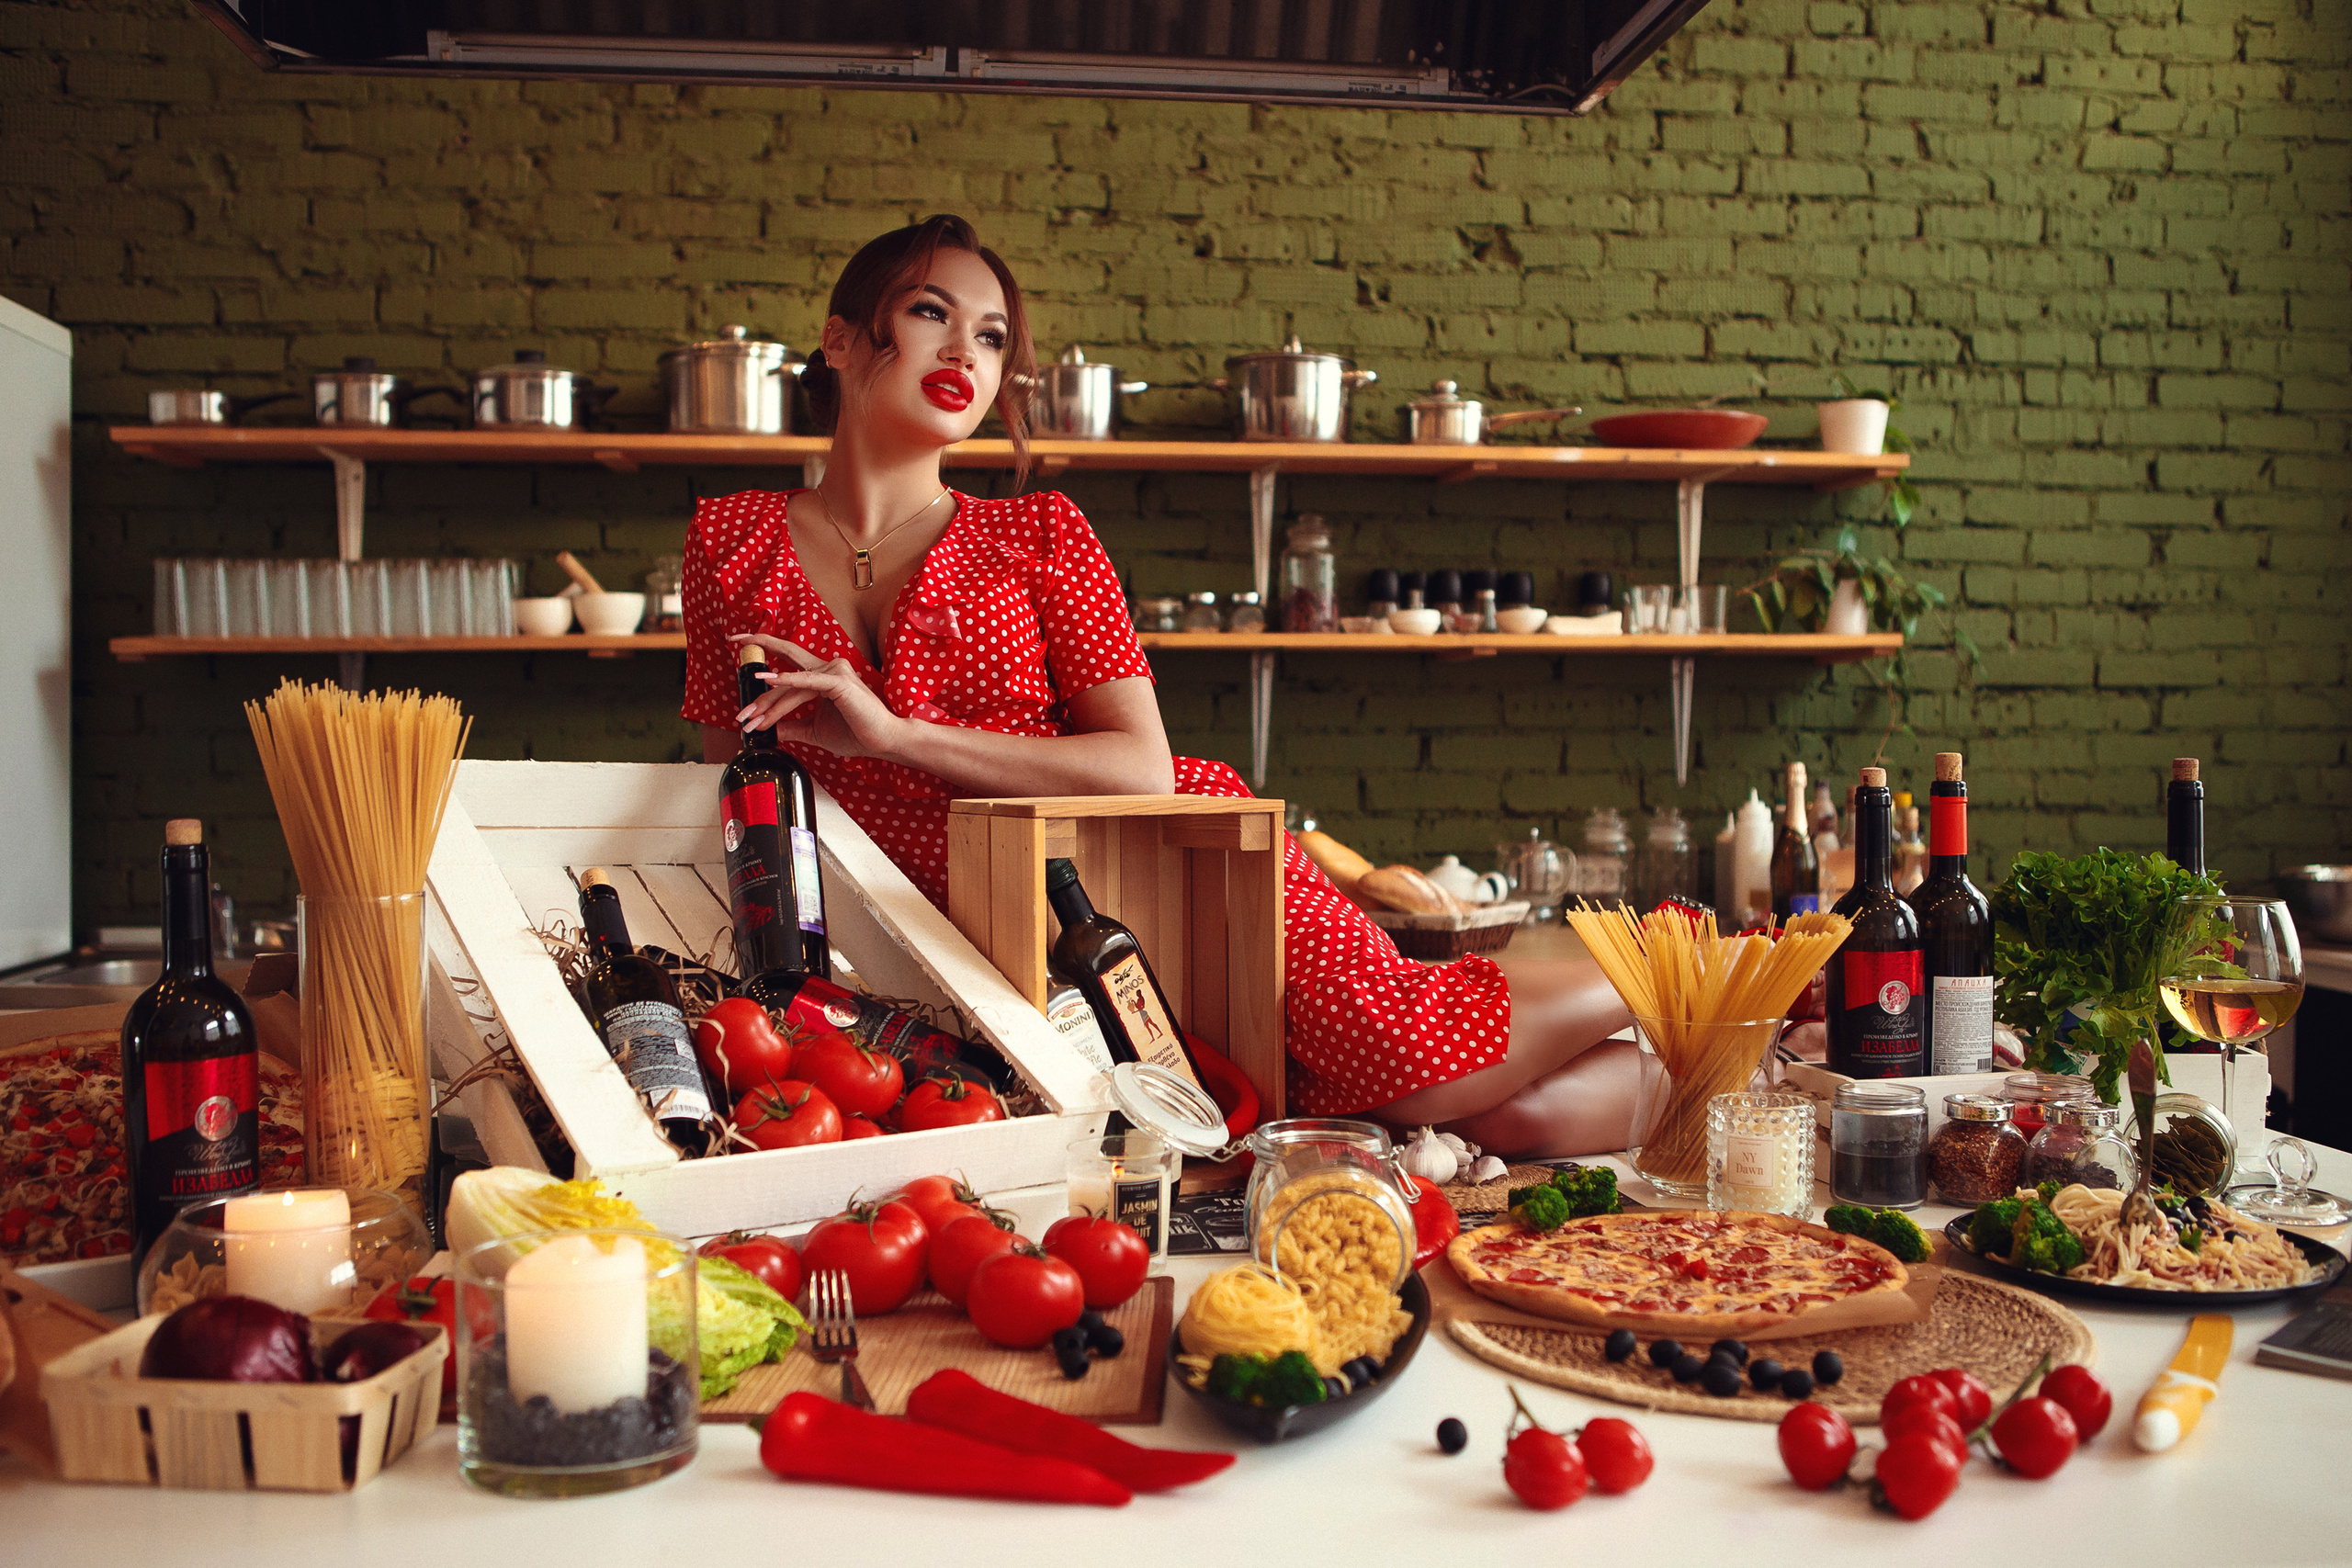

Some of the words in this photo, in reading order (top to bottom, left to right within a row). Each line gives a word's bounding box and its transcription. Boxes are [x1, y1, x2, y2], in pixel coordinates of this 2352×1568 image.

[1116, 975, 1145, 1005] MINOS
[1055, 1010, 1091, 1034] MONINI
[1861, 1040, 1920, 1054] ИЗАБЕЛЛА
[1742, 1151, 1757, 1163] NY
[1736, 1163, 1764, 1176] Dawn
[173, 1168, 254, 1193] ИЗАБЕЛЛА
[1122, 1198, 1159, 1214] JASMIN
[1134, 1224, 1152, 1238] UIT
